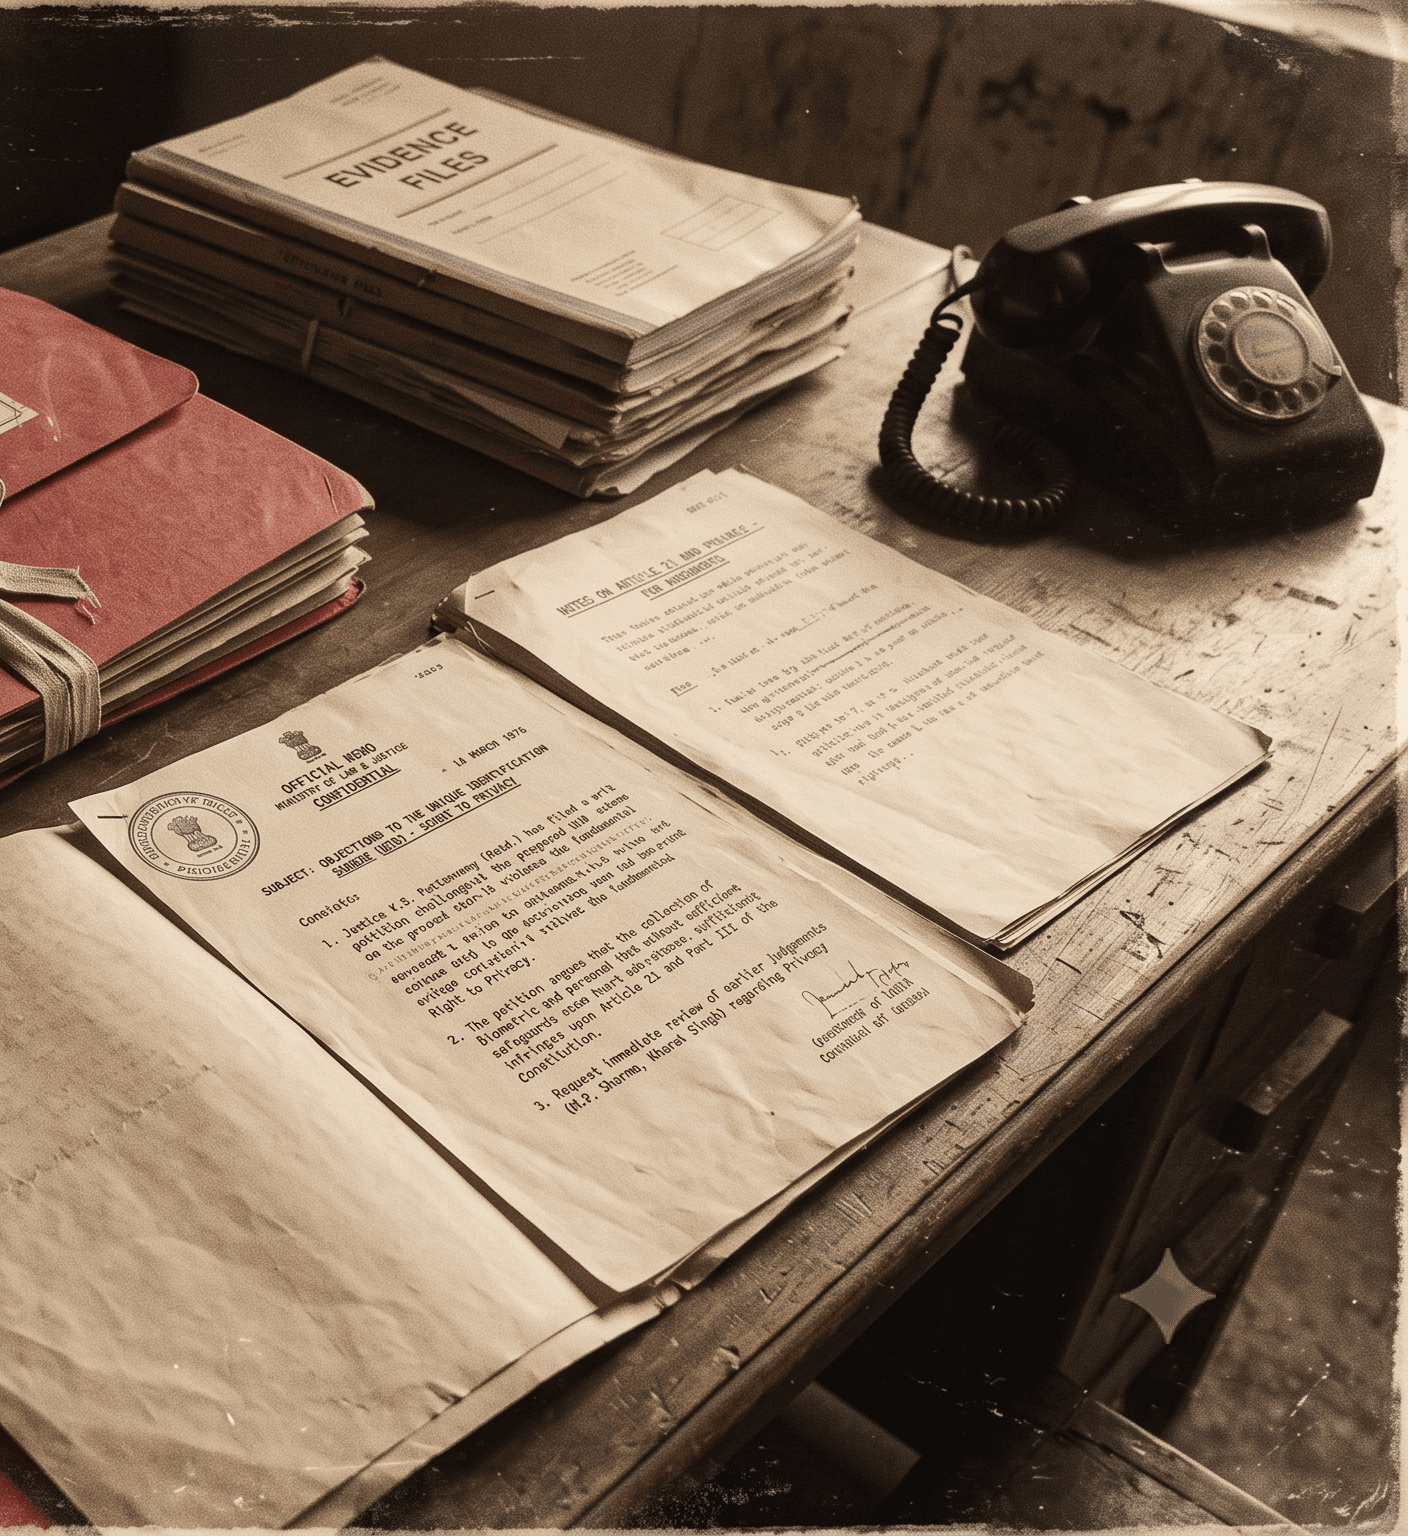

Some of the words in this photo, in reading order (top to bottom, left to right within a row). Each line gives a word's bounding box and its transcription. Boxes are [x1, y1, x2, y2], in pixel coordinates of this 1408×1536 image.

[324, 121, 478, 188] EVIDENCE
[398, 150, 489, 190] FILES
[502, 725, 527, 741] 1976
[280, 760, 344, 794] OFFICIAL
[260, 867, 315, 896] SUBJECT:
[384, 821, 403, 833] TO
[402, 808, 426, 823] THE
[446, 1034, 465, 1045] 2.
[464, 1017, 490, 1032] The
[615, 928, 638, 943] the
[699, 878, 714, 892] of
[567, 1011, 597, 1031] upon
[599, 983, 643, 1012] Article
[643, 970, 661, 984] 21
[663, 954, 685, 973] and
[740, 910, 754, 925] of
[755, 899, 779, 913] the
[465, 984, 483, 996] to
[550, 1066, 603, 1099] Request
[706, 987, 720, 1003] of
[686, 1007, 727, 1036] Singh)
